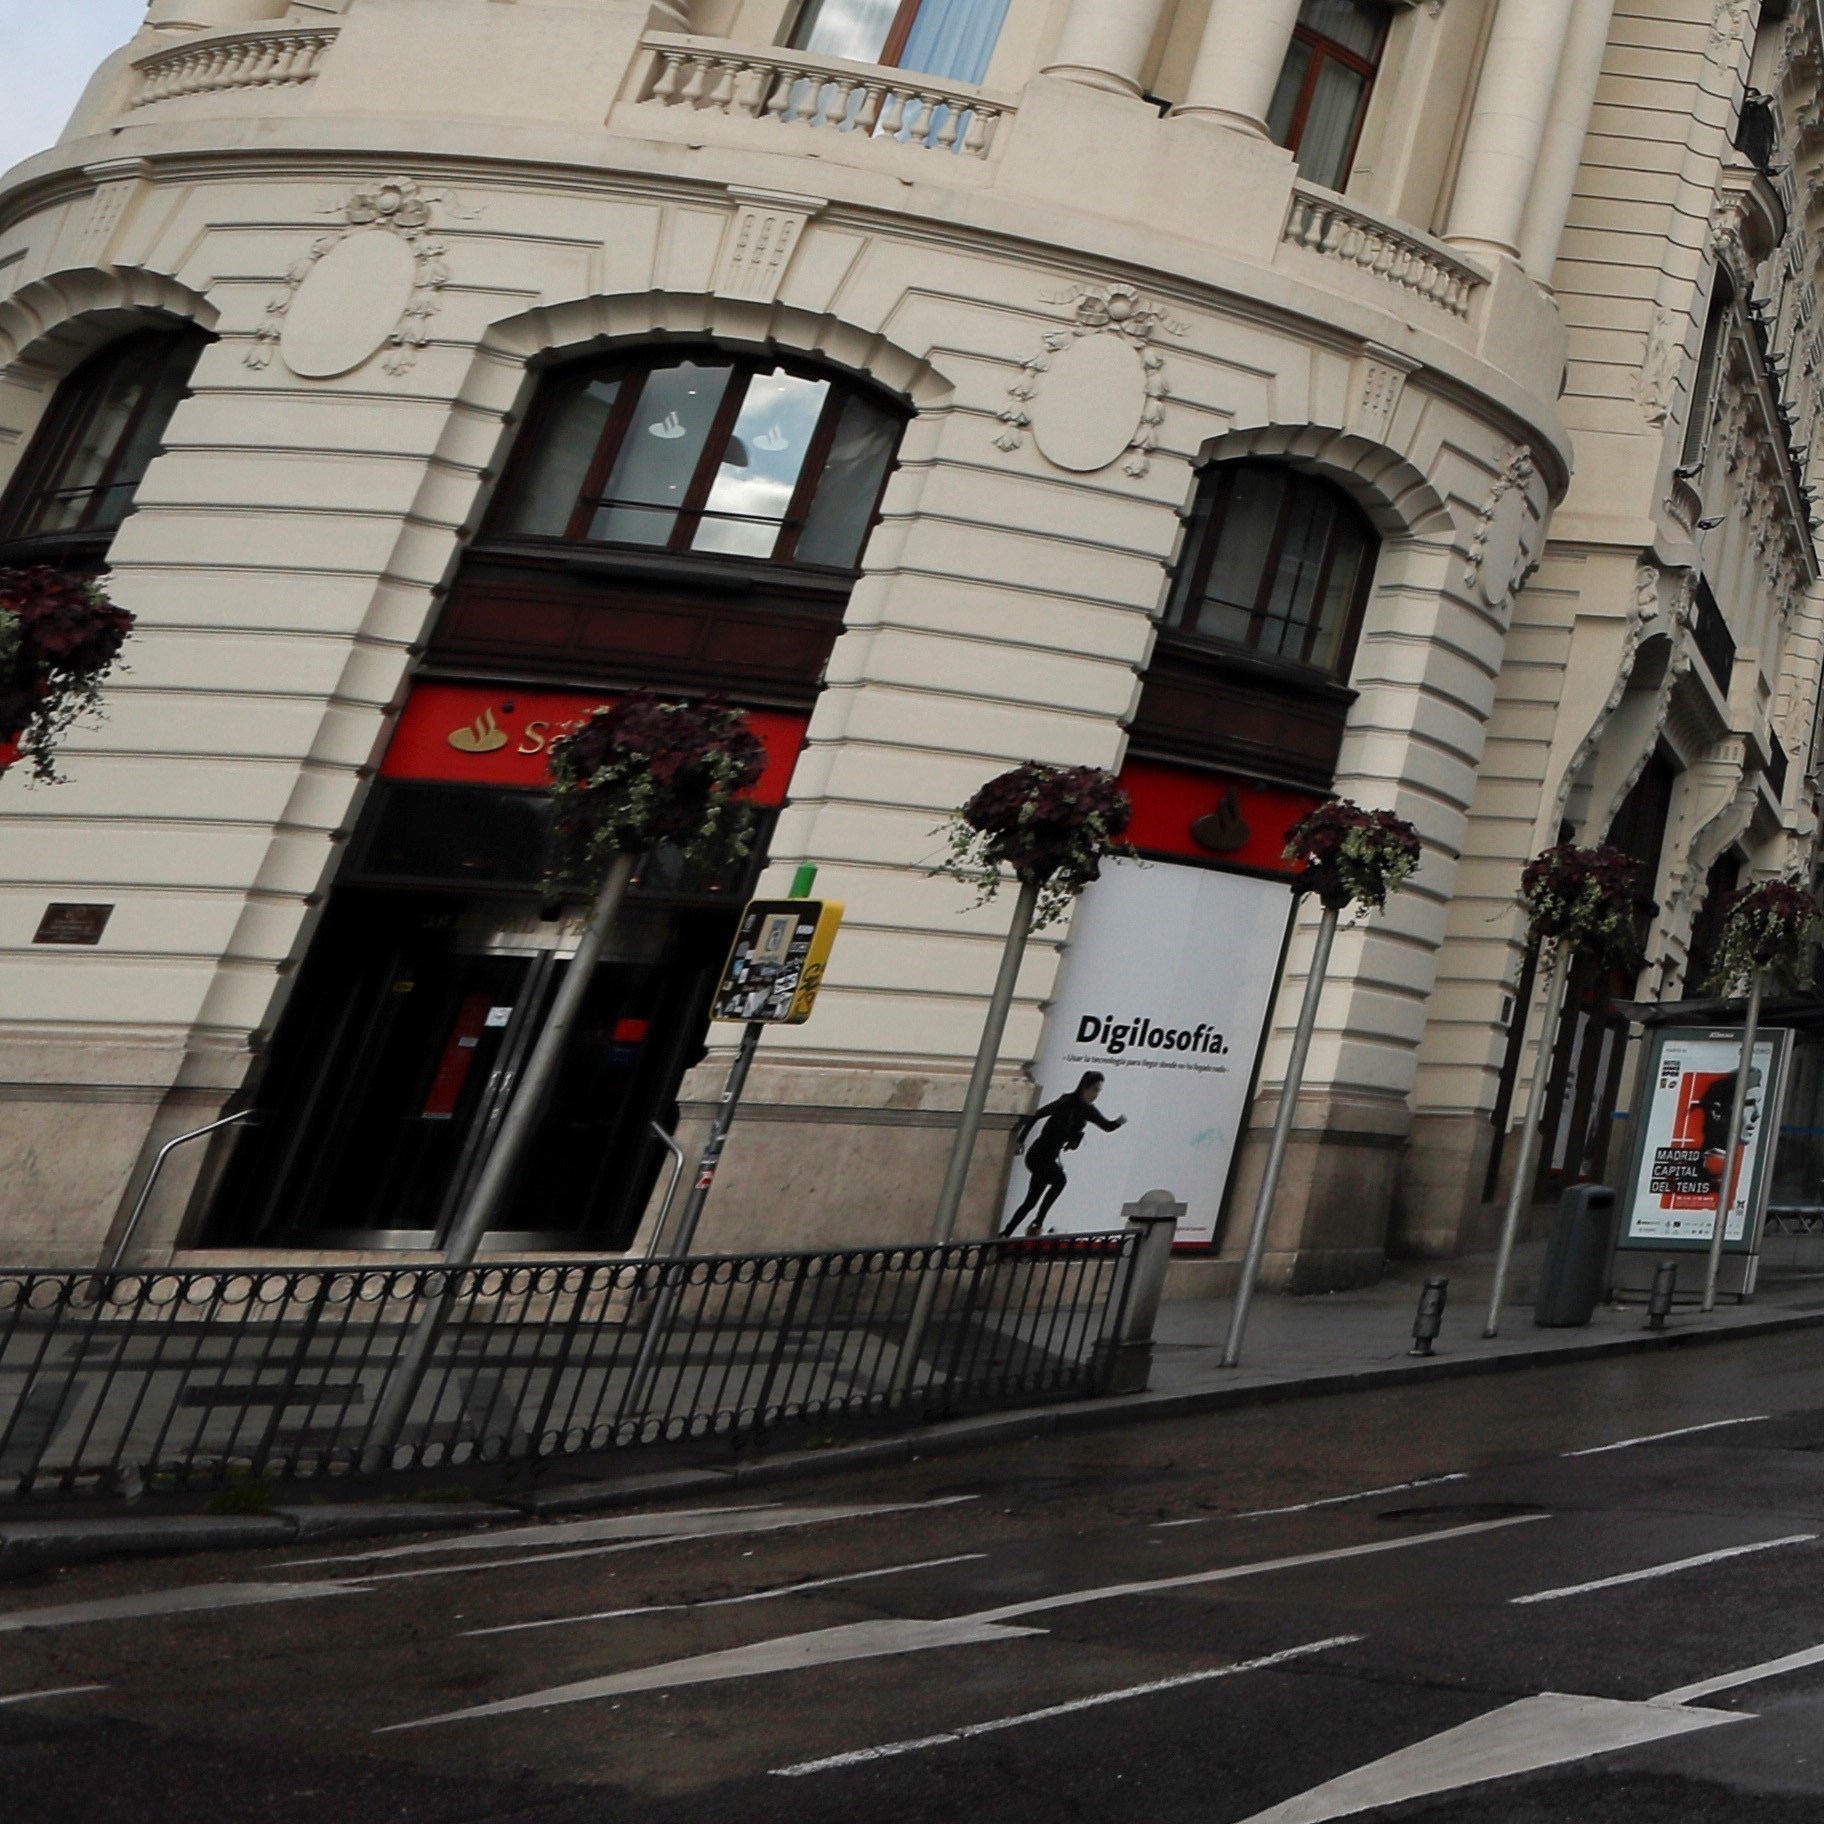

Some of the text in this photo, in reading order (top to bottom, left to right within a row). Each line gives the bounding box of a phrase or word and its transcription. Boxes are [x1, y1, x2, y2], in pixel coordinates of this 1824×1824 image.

[1076, 1014, 1230, 1055] Digilosofía.
[1656, 1149, 1701, 1161] MADRID
[1654, 1165, 1699, 1177] CAPITAL
[1651, 1181, 1710, 1194] DEL TENIS
